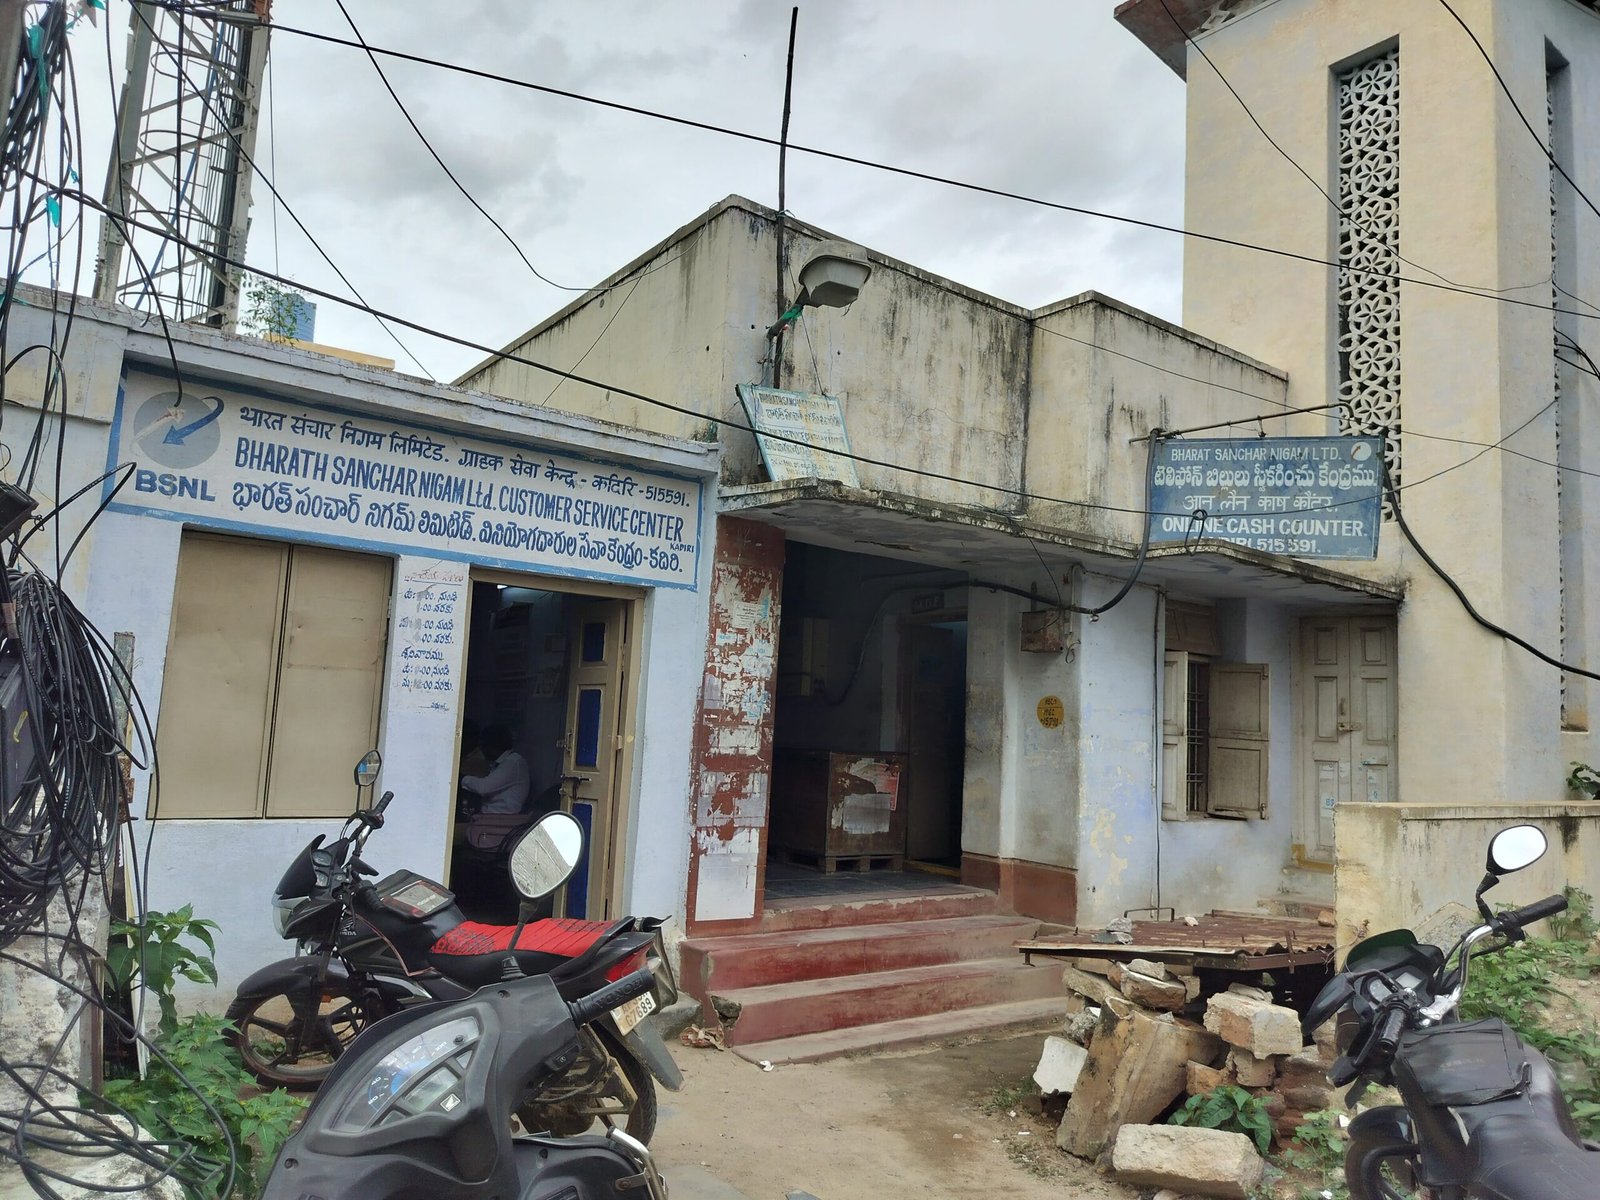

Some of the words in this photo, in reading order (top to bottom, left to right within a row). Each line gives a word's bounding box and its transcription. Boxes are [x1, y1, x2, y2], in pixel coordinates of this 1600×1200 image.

[291, 413, 336, 440] संचार
[340, 420, 386, 450] निगम
[458, 449, 503, 471] ग्राहक
[510, 453, 541, 478] सेवा
[544, 460, 578, 489] केन्द्र
[1171, 448, 1211, 461] BHARAT
[1215, 447, 1267, 461] SANCHAR
[1270, 447, 1308, 461] NIGAM
[1312, 447, 1342, 460] LTD.
[135, 469, 216, 501] BSNL
[235, 437, 328, 482] BHARATH
[332, 455, 418, 497] SANCHAR
[417, 471, 466, 505] NIGAM
[466, 479, 497, 511] Ltd.
[499, 485, 573, 523] CUSTOMER
[573, 498, 630, 533] SERVICE
[630, 509, 684, 542] CENTER
[1154, 465, 1203, 489] టెలిఫోన్
[1206, 468, 1250, 491] బిల్లులు
[1183, 494, 1216, 511] आन
[1220, 489, 1252, 511] लैन
[232, 481, 293, 514] భారత్
[295, 486, 362, 525] సంచార్
[365, 502, 416, 533] నిగమ్
[478, 519, 577, 558] వినియోగదారుల
[1162, 516, 1225, 533] ONLINE
[1226, 518, 1275, 534] CASH
[1279, 519, 1368, 537] COUNTER.
[668, 542, 695, 554] KADIRI
